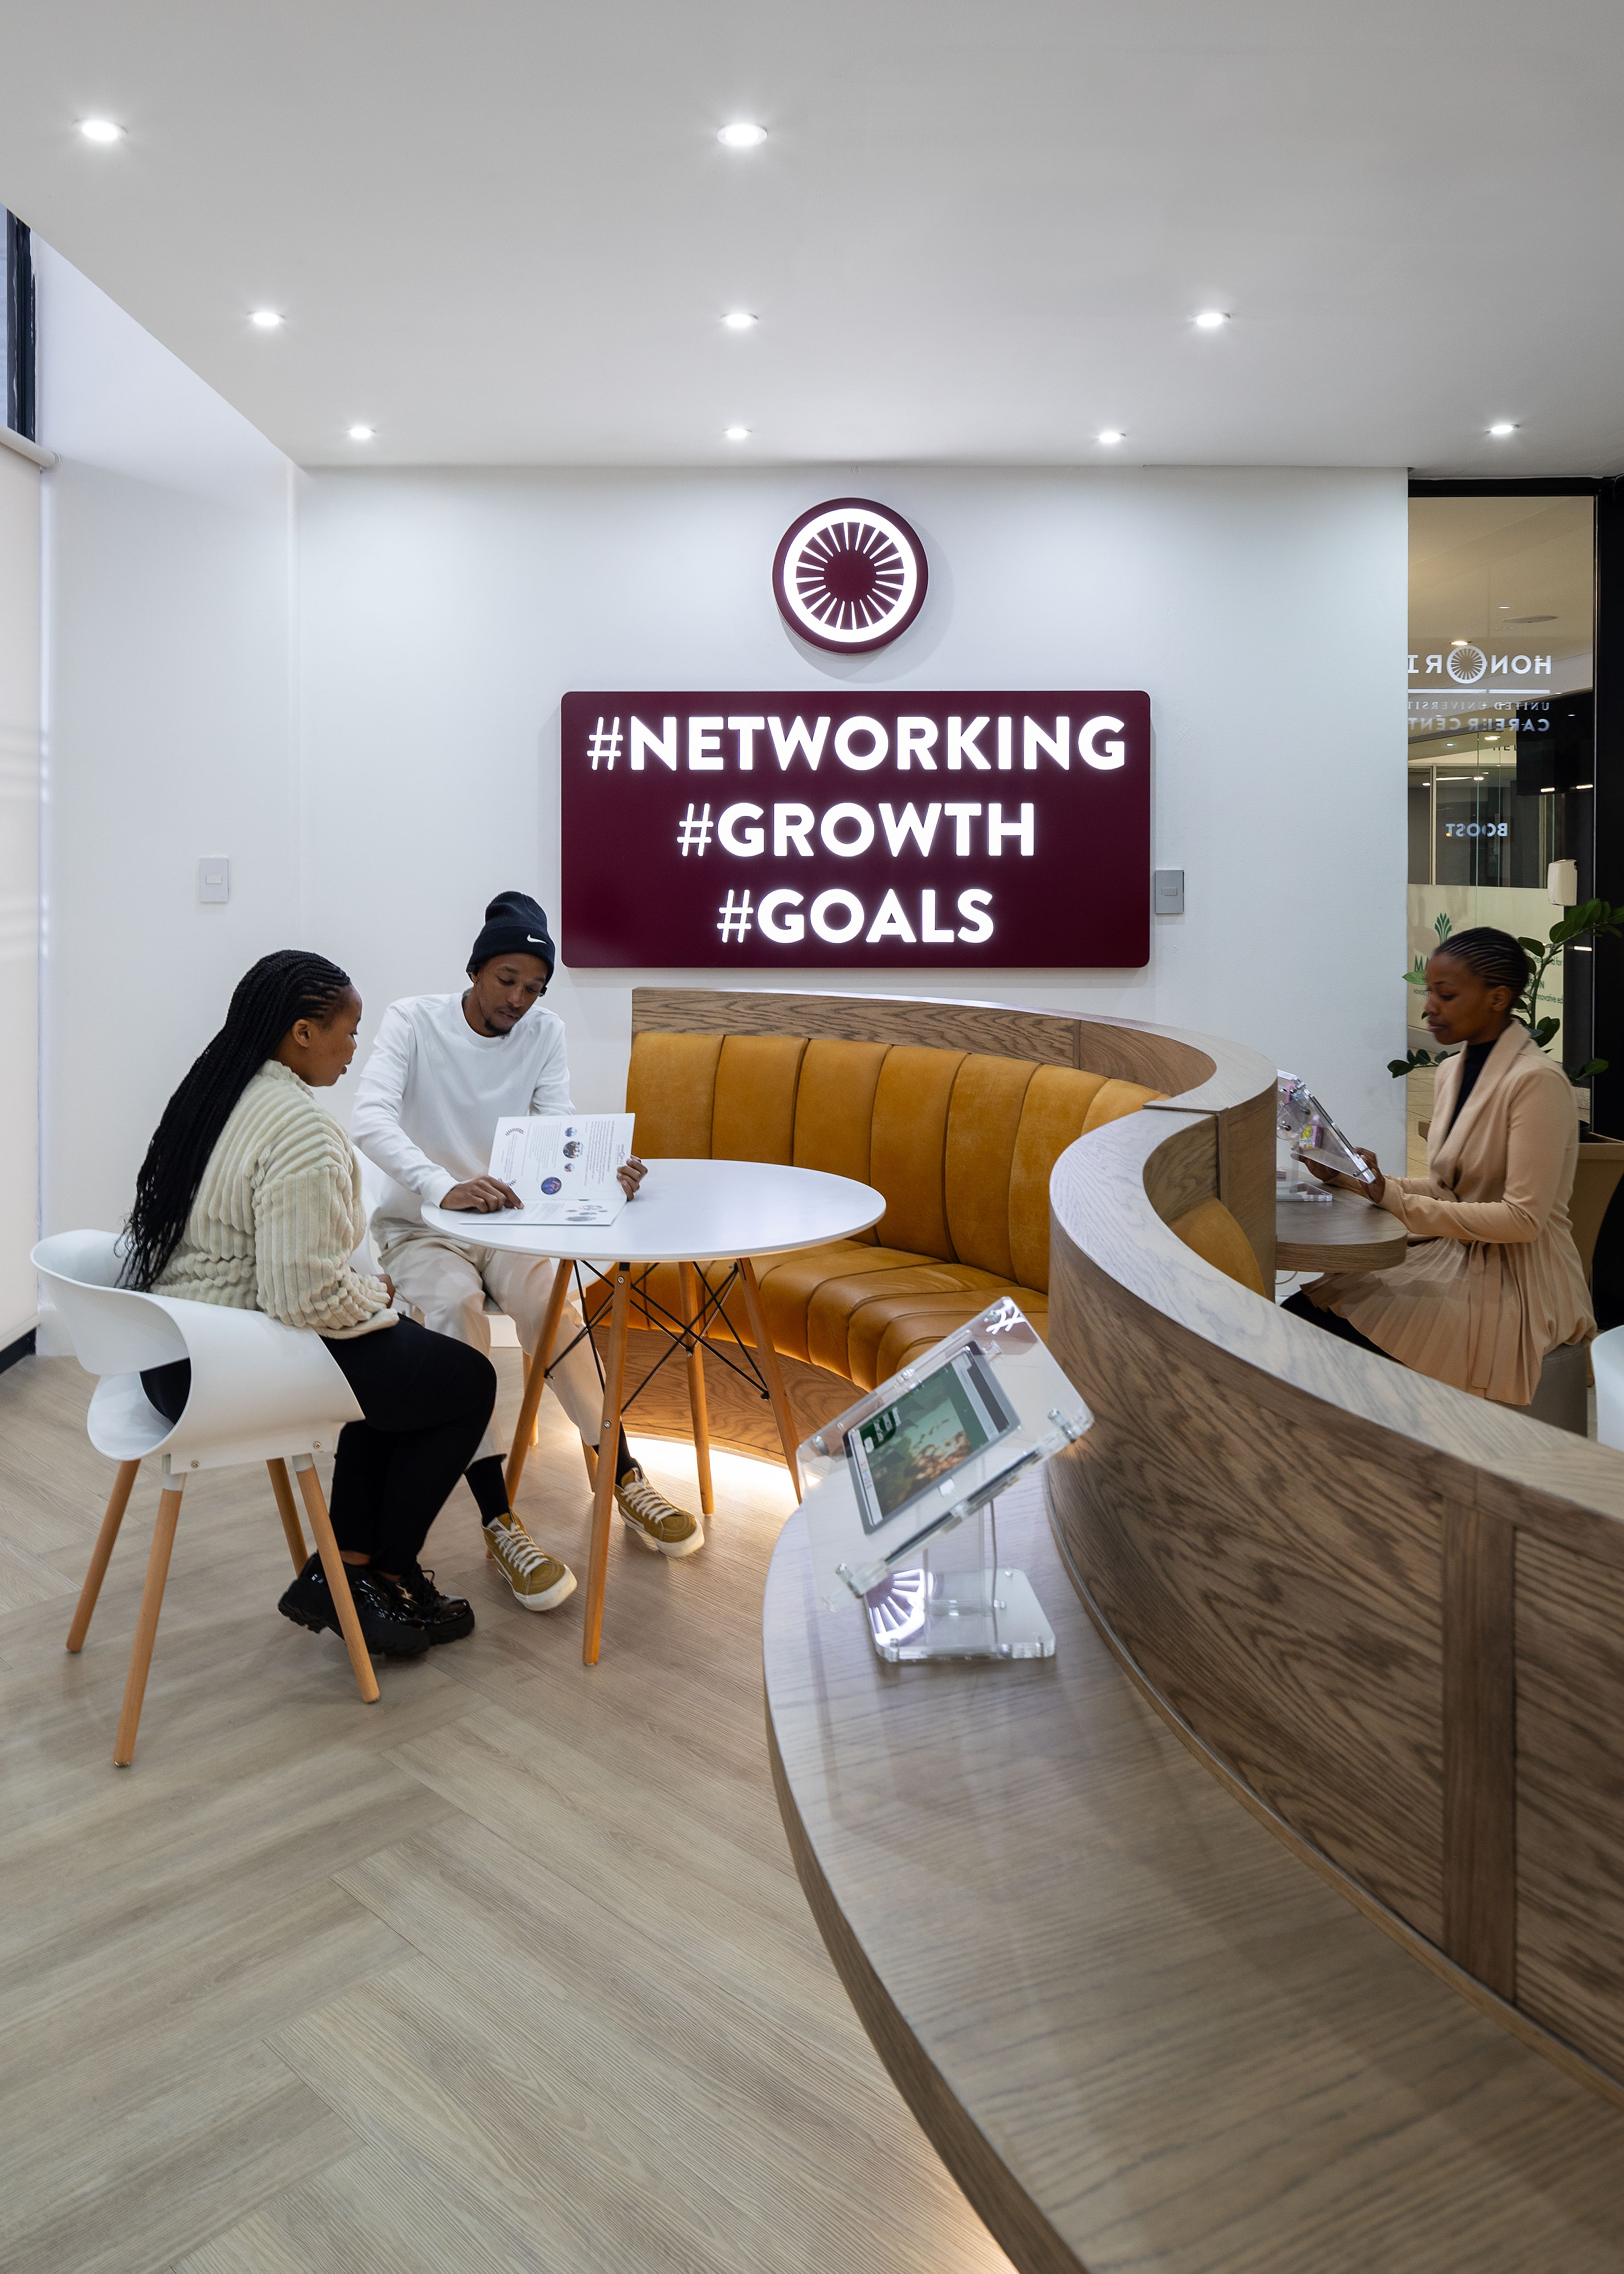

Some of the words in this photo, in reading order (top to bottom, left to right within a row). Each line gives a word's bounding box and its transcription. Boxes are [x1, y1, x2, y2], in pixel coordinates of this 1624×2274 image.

[586, 715, 1125, 772] #NETWORKING
[676, 802, 1035, 858] #GROWTH
[716, 888, 994, 944] #GOALS
